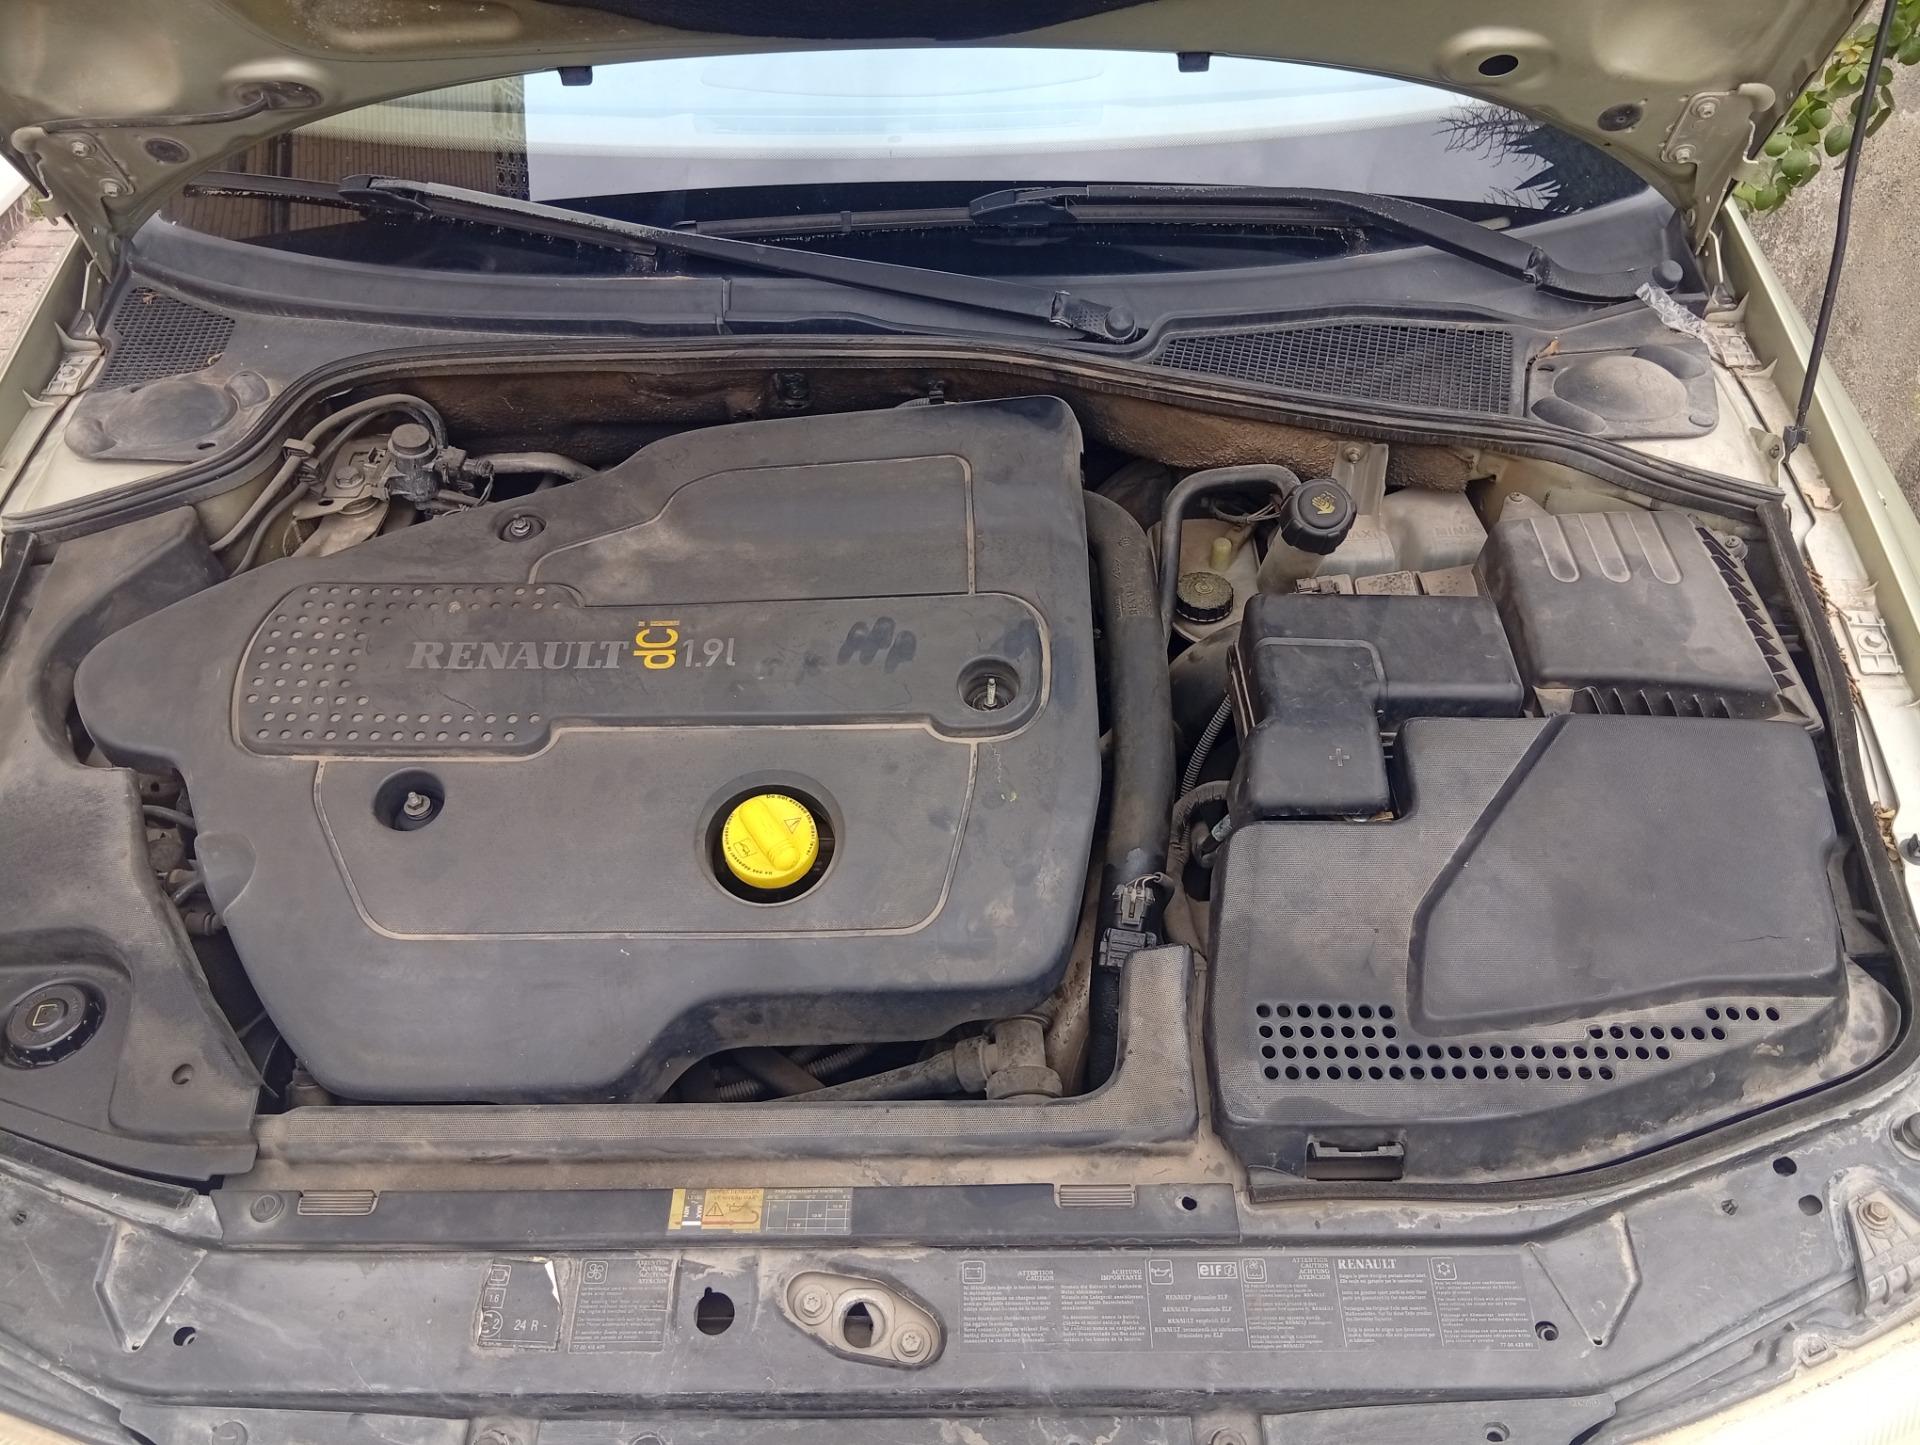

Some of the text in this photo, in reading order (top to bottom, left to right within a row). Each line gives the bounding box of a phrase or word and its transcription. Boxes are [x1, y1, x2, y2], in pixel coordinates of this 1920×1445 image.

[405, 640, 630, 670] RENAULT
[789, 799, 808, 814] exceed
[696, 1204, 705, 1219] MAX
[1199, 1264, 1222, 1276] elf
[1338, 1258, 1397, 1270] RENAULT
[513, 1319, 528, 1331] 24
[530, 1319, 540, 1332] R
